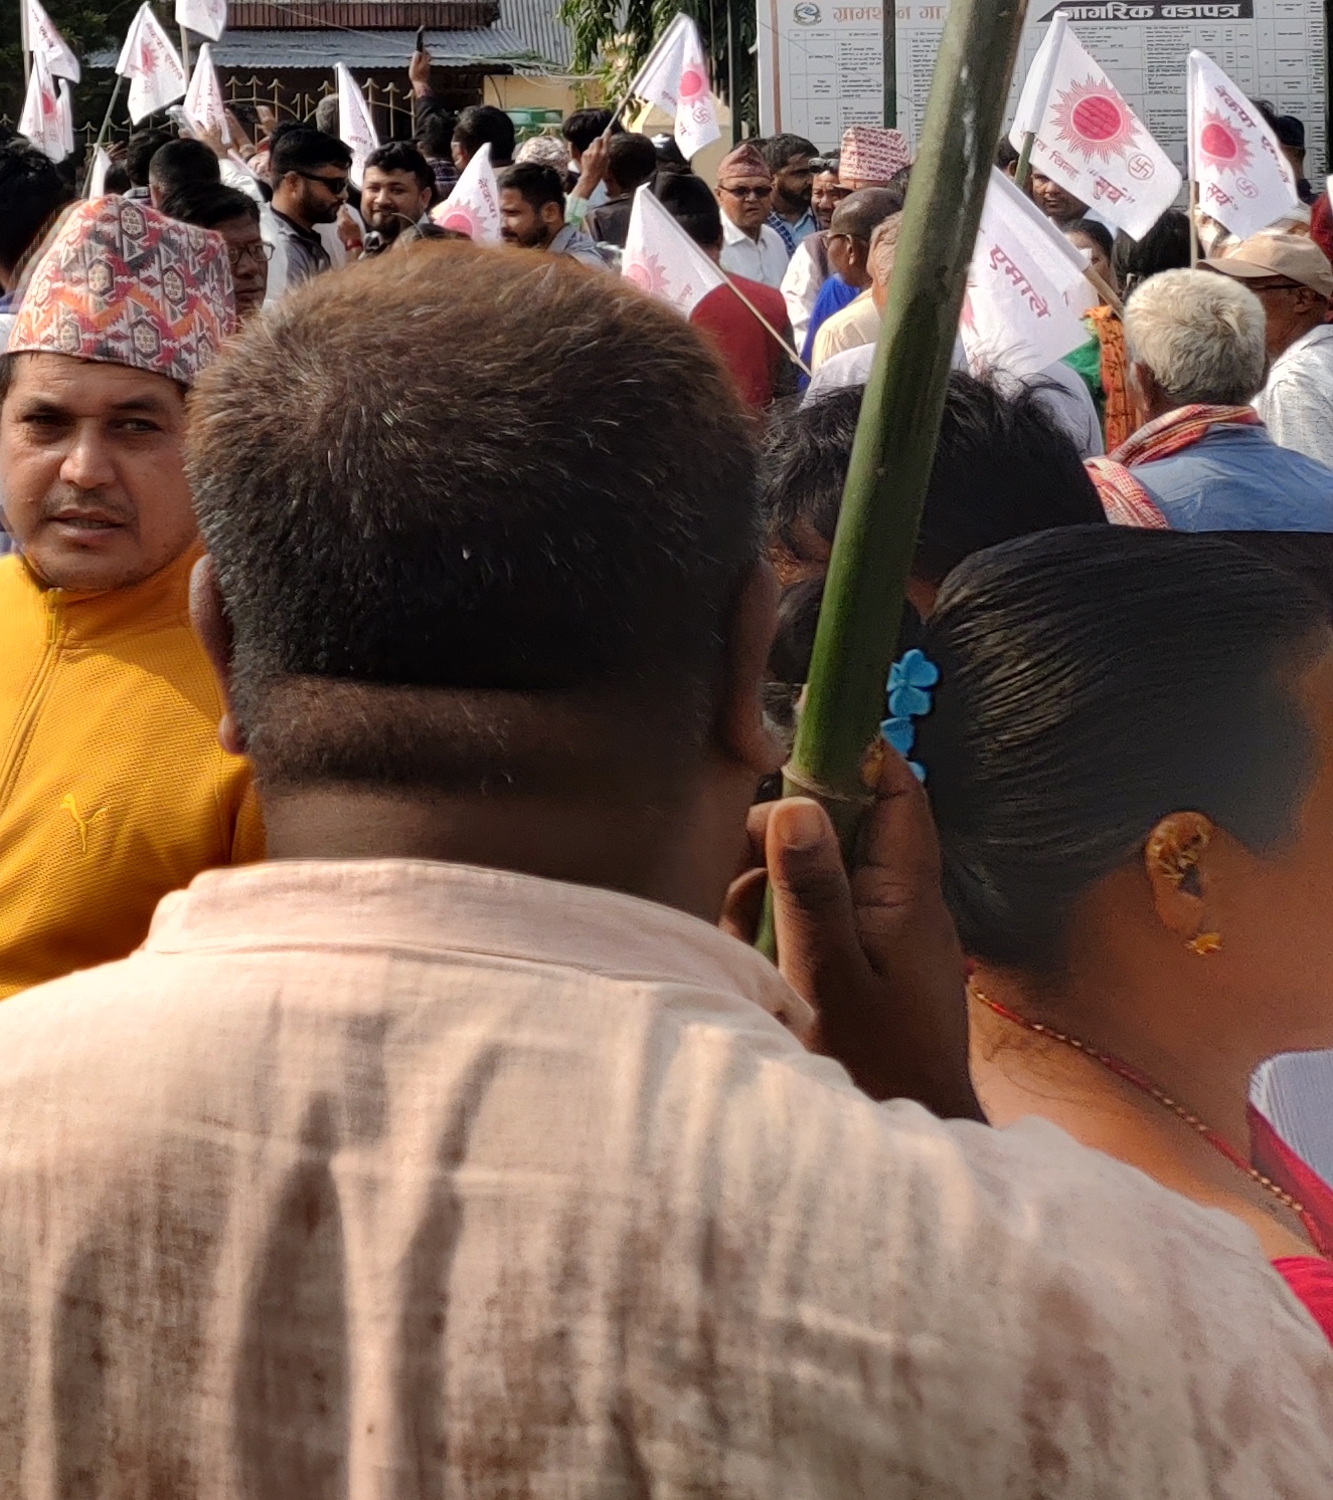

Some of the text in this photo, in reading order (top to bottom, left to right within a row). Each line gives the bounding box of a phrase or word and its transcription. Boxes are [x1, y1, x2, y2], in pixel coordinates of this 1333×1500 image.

[833, 4, 910, 24] ग्रामथन
[1162, 3, 1241, 20] वडापत्र
[1214, 84, 1257, 129] नेकपा
[989, 244, 1052, 320] एमाले
